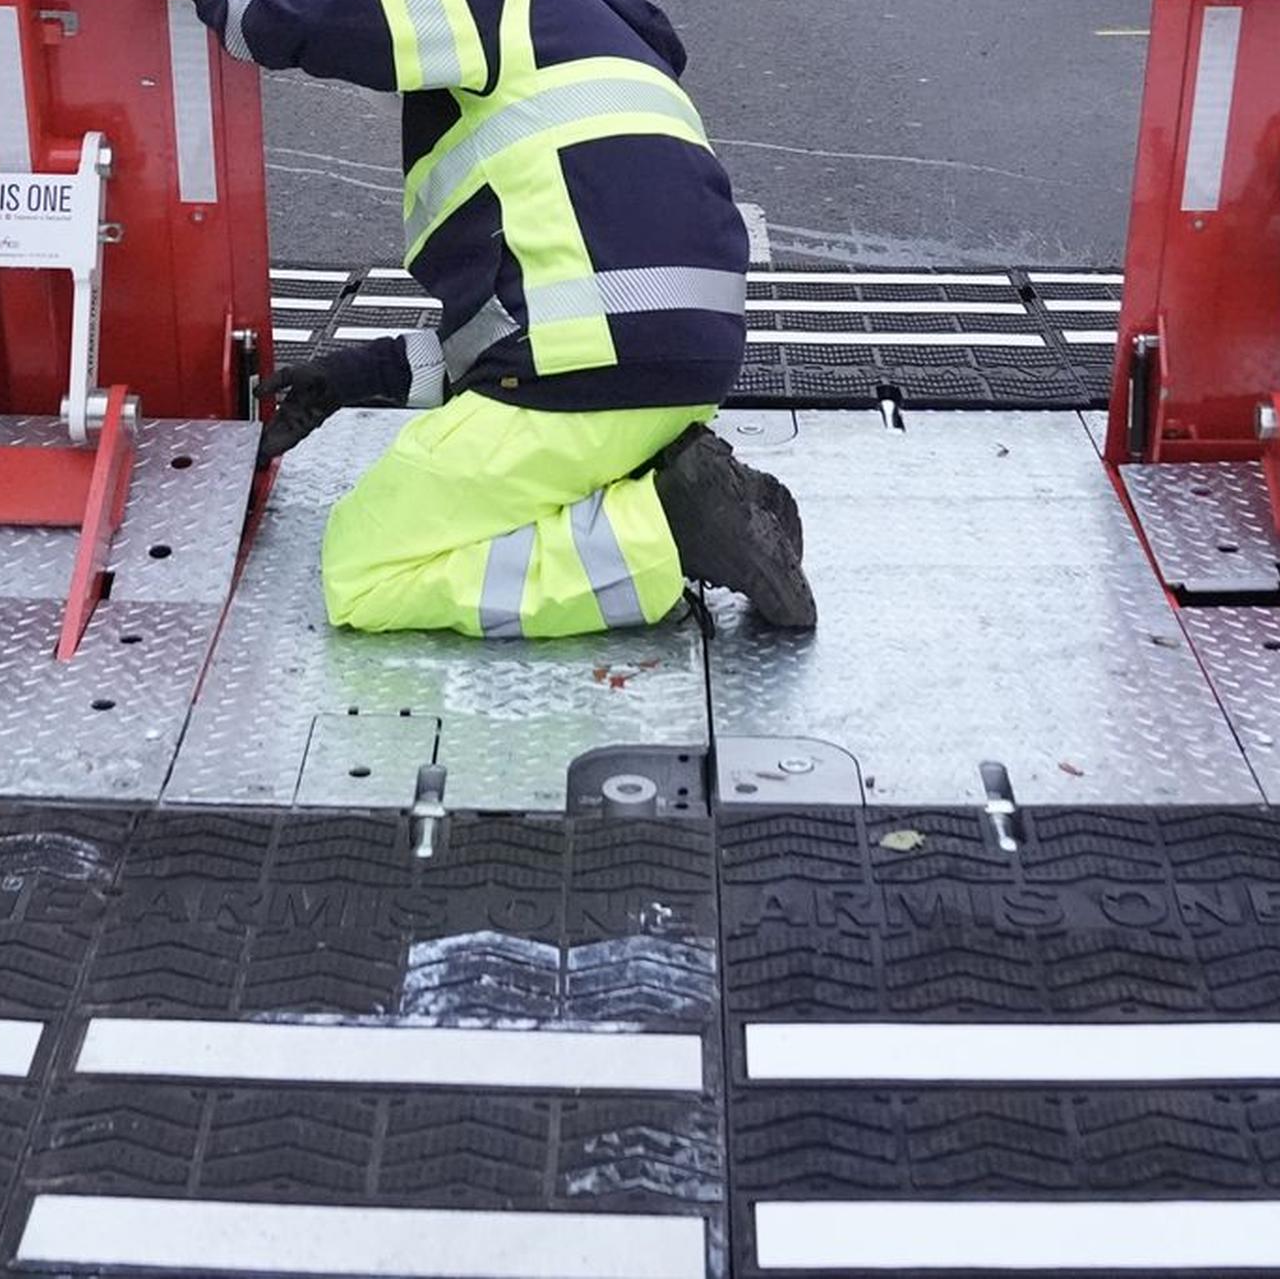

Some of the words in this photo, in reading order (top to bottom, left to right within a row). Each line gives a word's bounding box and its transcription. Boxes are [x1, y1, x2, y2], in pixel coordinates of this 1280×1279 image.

[27, 185, 73, 212] ONE
[132, 888, 452, 932] ARMIS
[483, 894, 702, 938] ONE
[740, 886, 1067, 929] ARMIS
